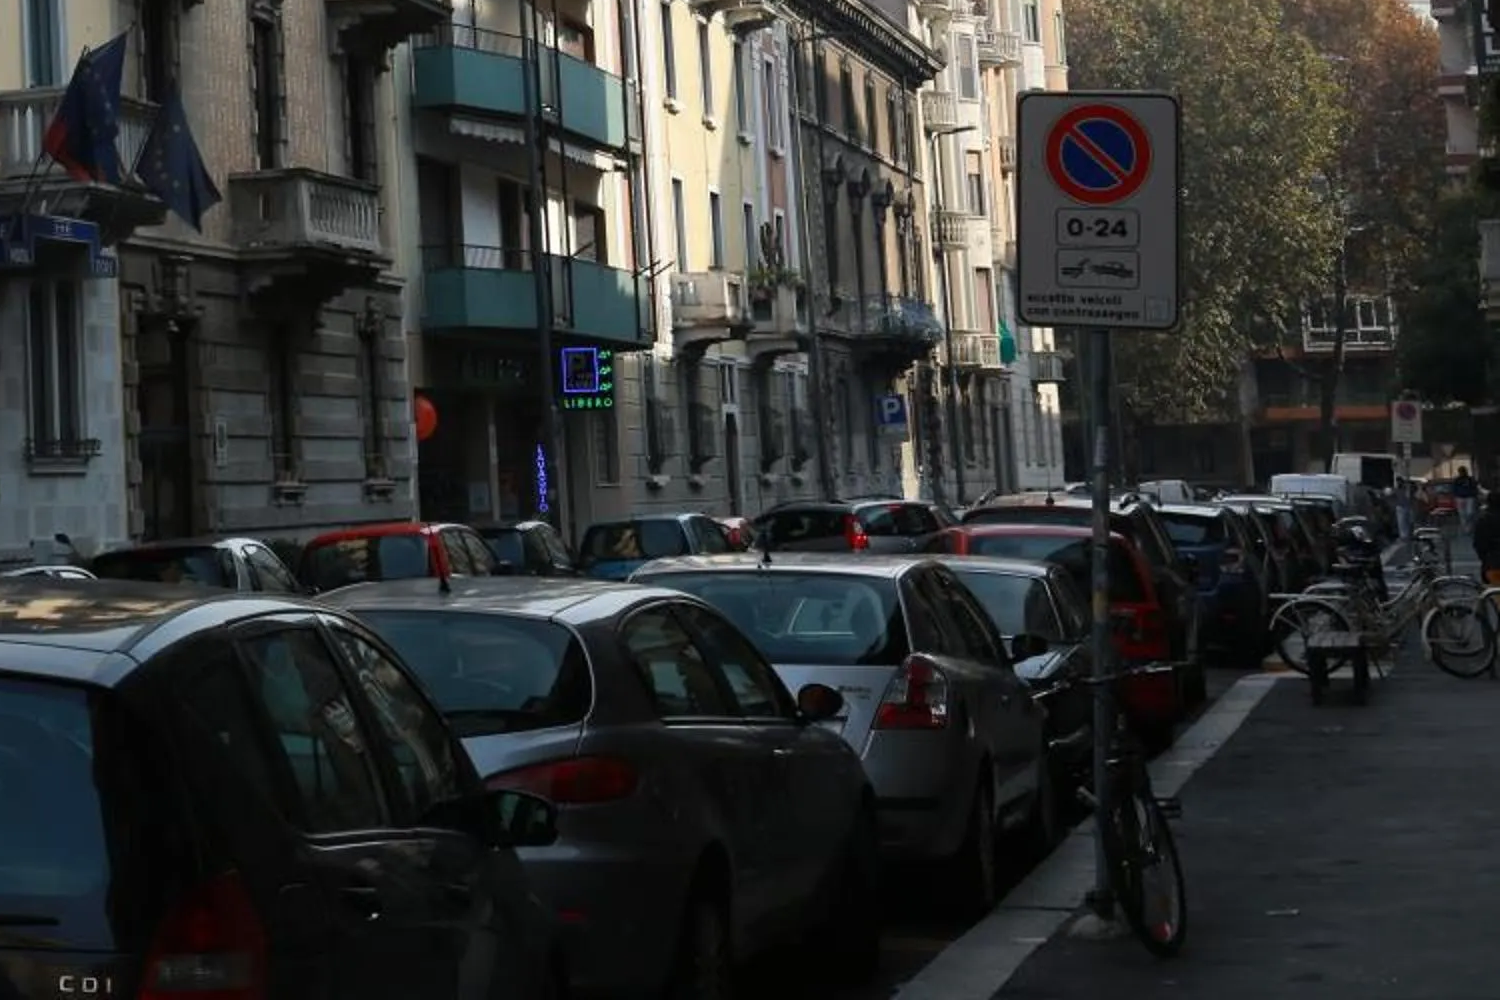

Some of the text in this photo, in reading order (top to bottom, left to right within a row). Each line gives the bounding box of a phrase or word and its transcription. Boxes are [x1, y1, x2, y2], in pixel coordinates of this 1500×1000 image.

[1066, 217, 1128, 238] 0-24
[1080, 294, 1123, 305] veicoli
[1052, 307, 1140, 320] contrassegno
[564, 397, 612, 409] LIBERO
[882, 398, 901, 422] P
[59, 975, 112, 993] CDI
